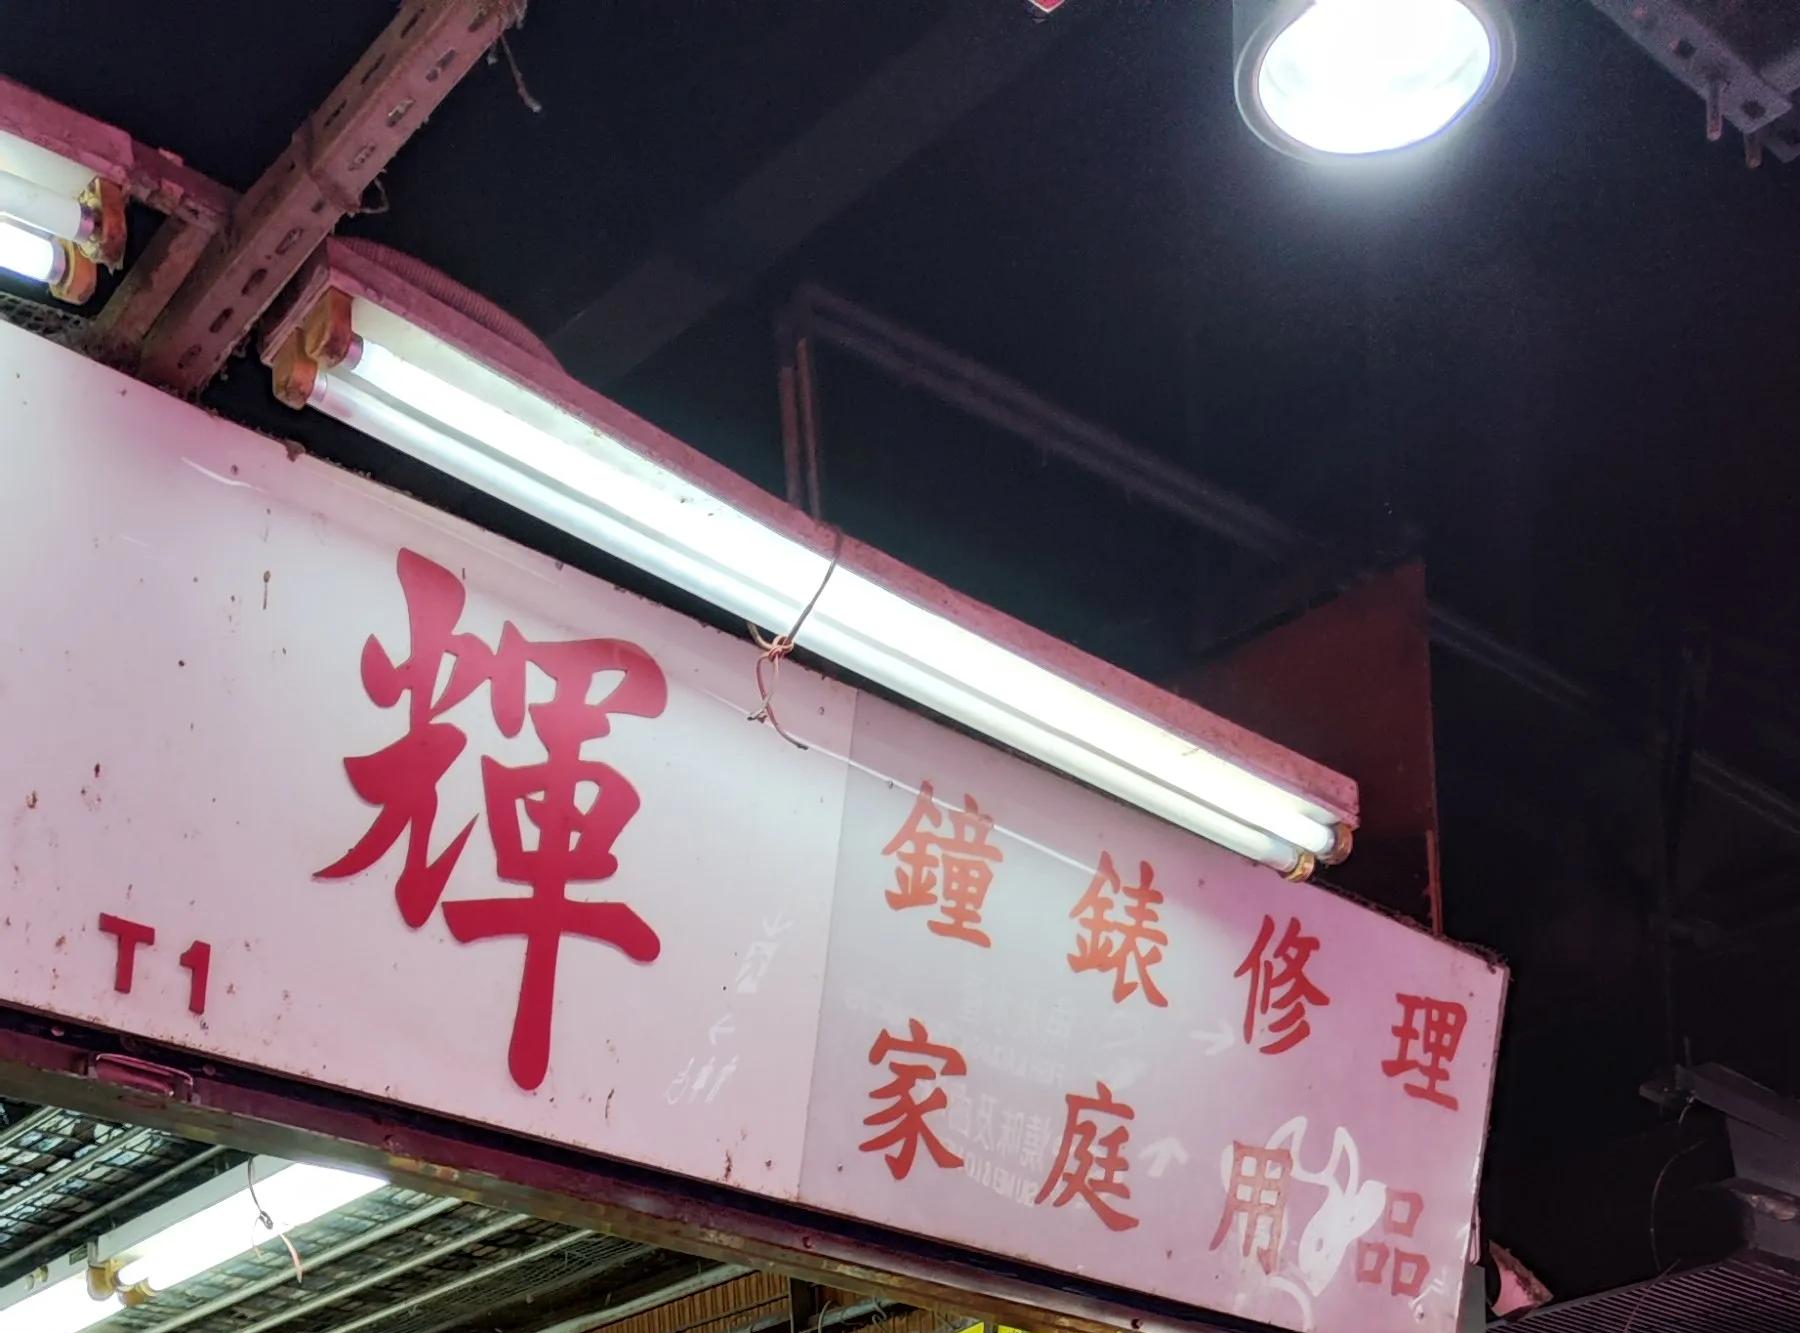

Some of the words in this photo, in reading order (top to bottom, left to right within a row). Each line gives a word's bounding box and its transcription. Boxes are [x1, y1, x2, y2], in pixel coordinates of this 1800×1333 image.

[99, 912, 212, 1016] T1
[312, 547, 668, 1091] 輝
[881, 780, 1467, 1111] 鐘錶修理
[858, 1017, 1431, 1297] 家庭用品
